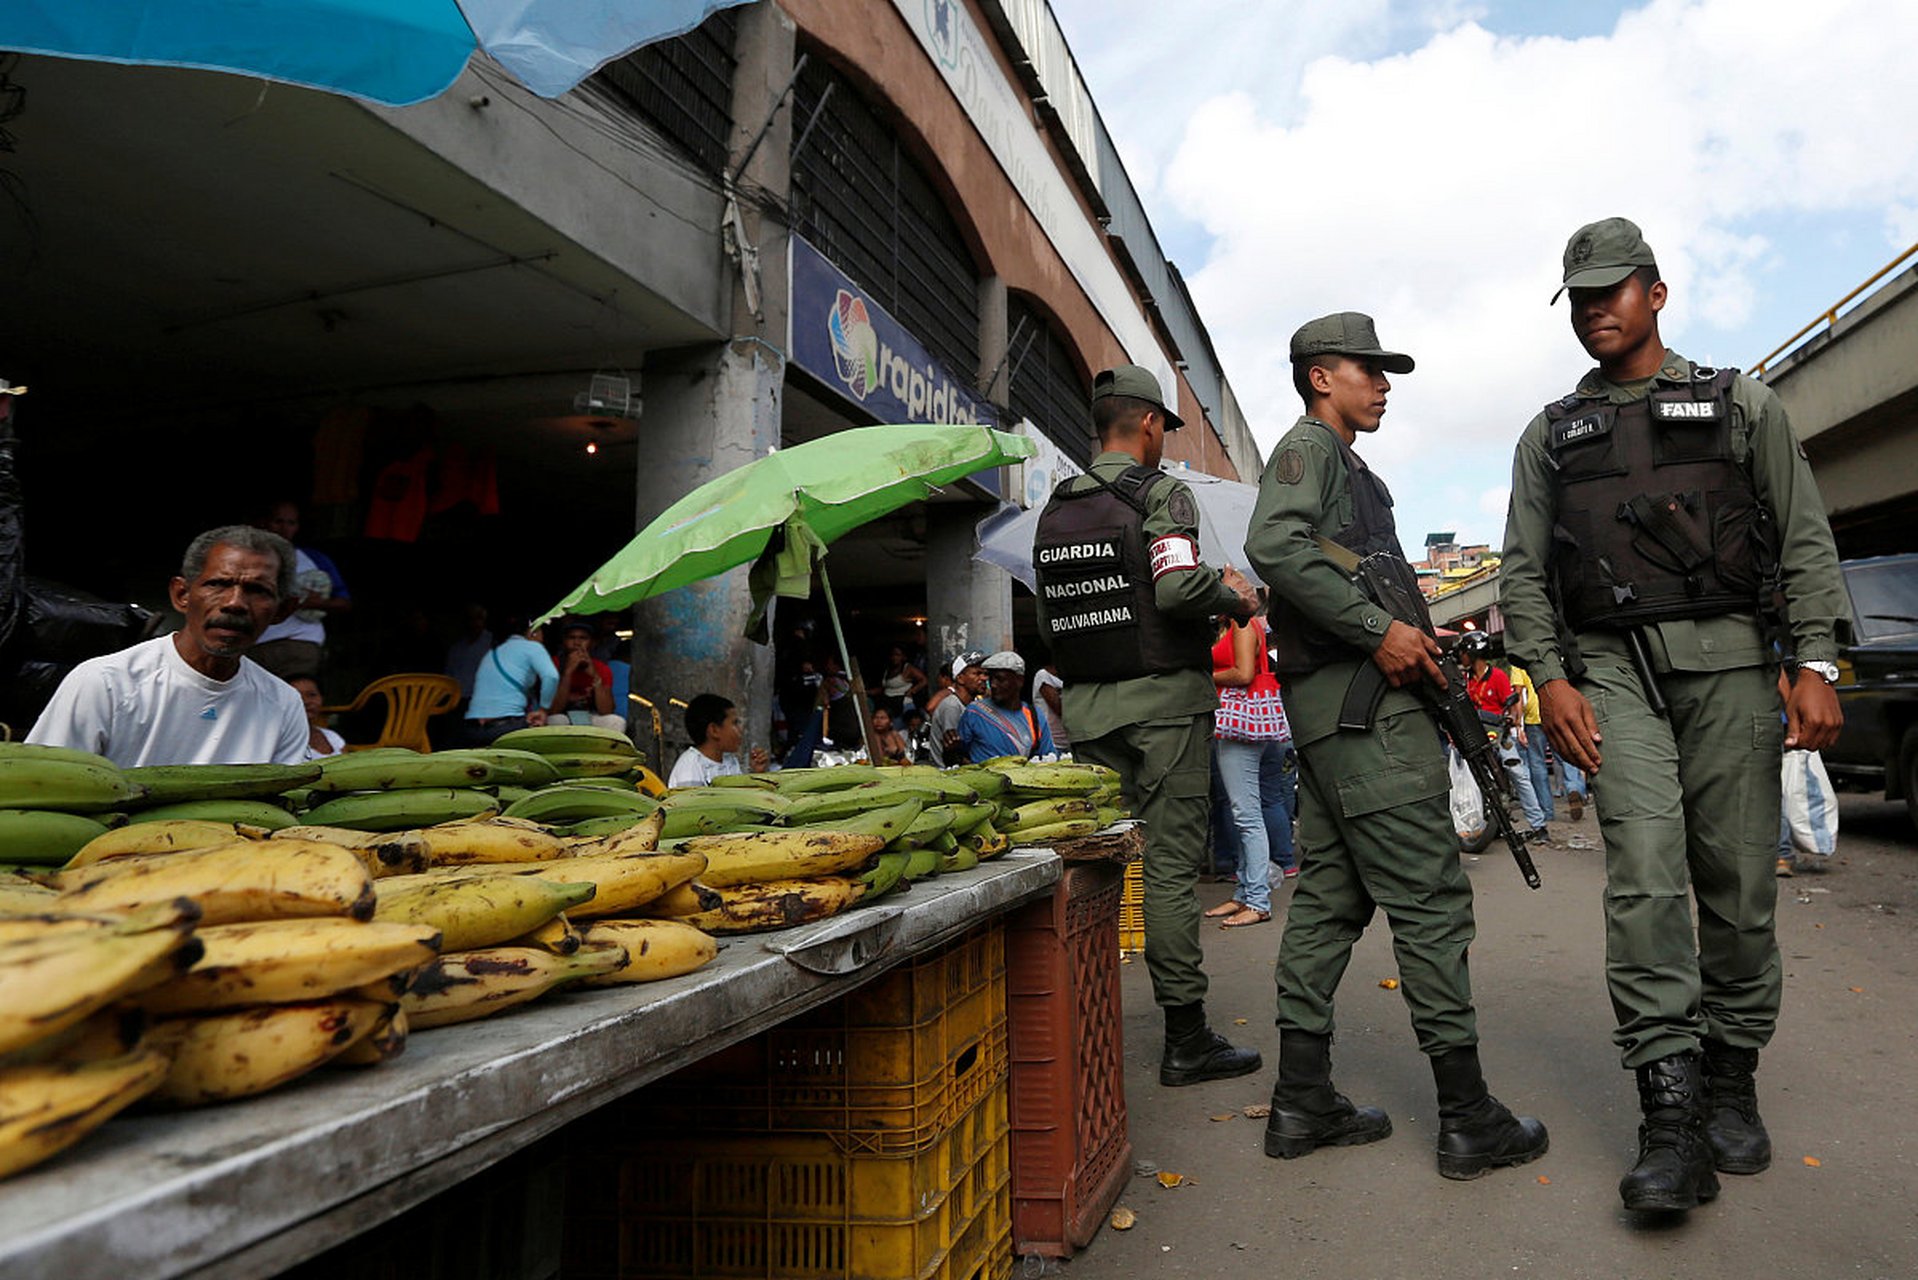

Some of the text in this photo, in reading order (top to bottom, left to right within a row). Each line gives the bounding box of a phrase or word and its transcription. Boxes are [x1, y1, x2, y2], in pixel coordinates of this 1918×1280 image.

[1661, 402, 1714, 418] FANB
[1039, 542, 1115, 563] GUARDIA
[1045, 574, 1130, 599] NACIONAL
[1051, 606, 1132, 632] BOLIVARIANA
